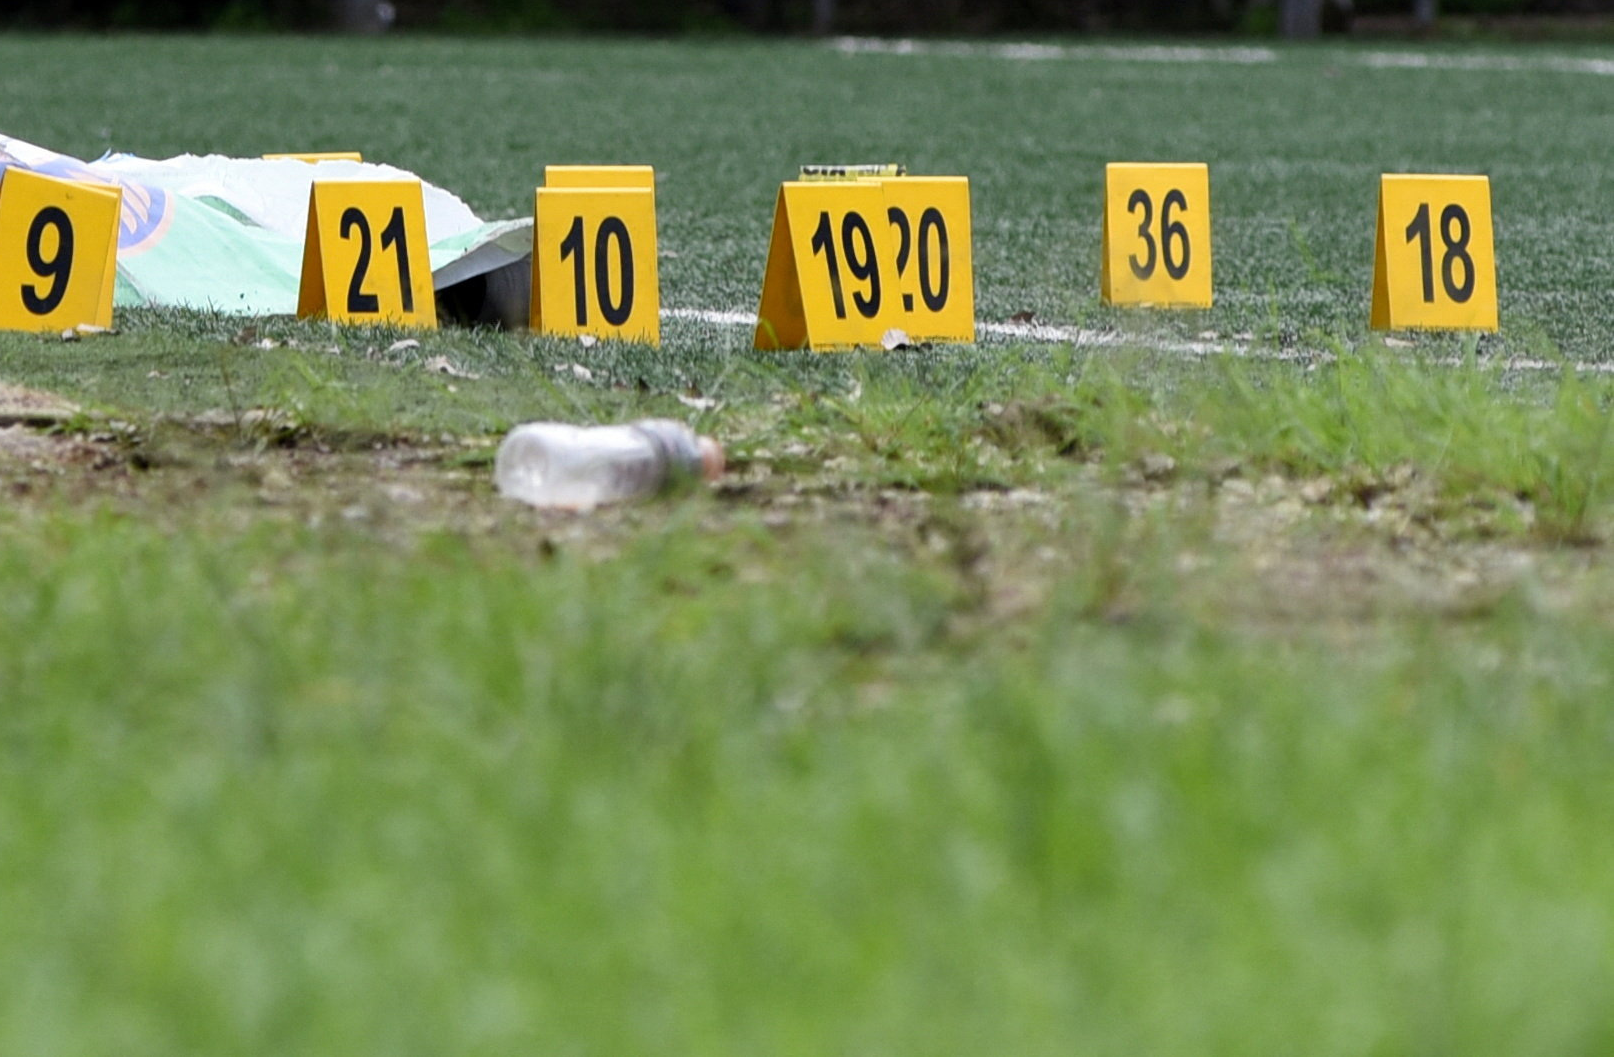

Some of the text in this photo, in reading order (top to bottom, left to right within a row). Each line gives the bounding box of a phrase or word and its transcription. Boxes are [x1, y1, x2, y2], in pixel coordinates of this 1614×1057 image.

[20, 205, 75, 316] 9
[339, 206, 414, 314] 21
[559, 215, 635, 327] 10
[810, 210, 882, 320] 19
[1127, 188, 1191, 281] 36
[1405, 203, 1476, 304] 18
